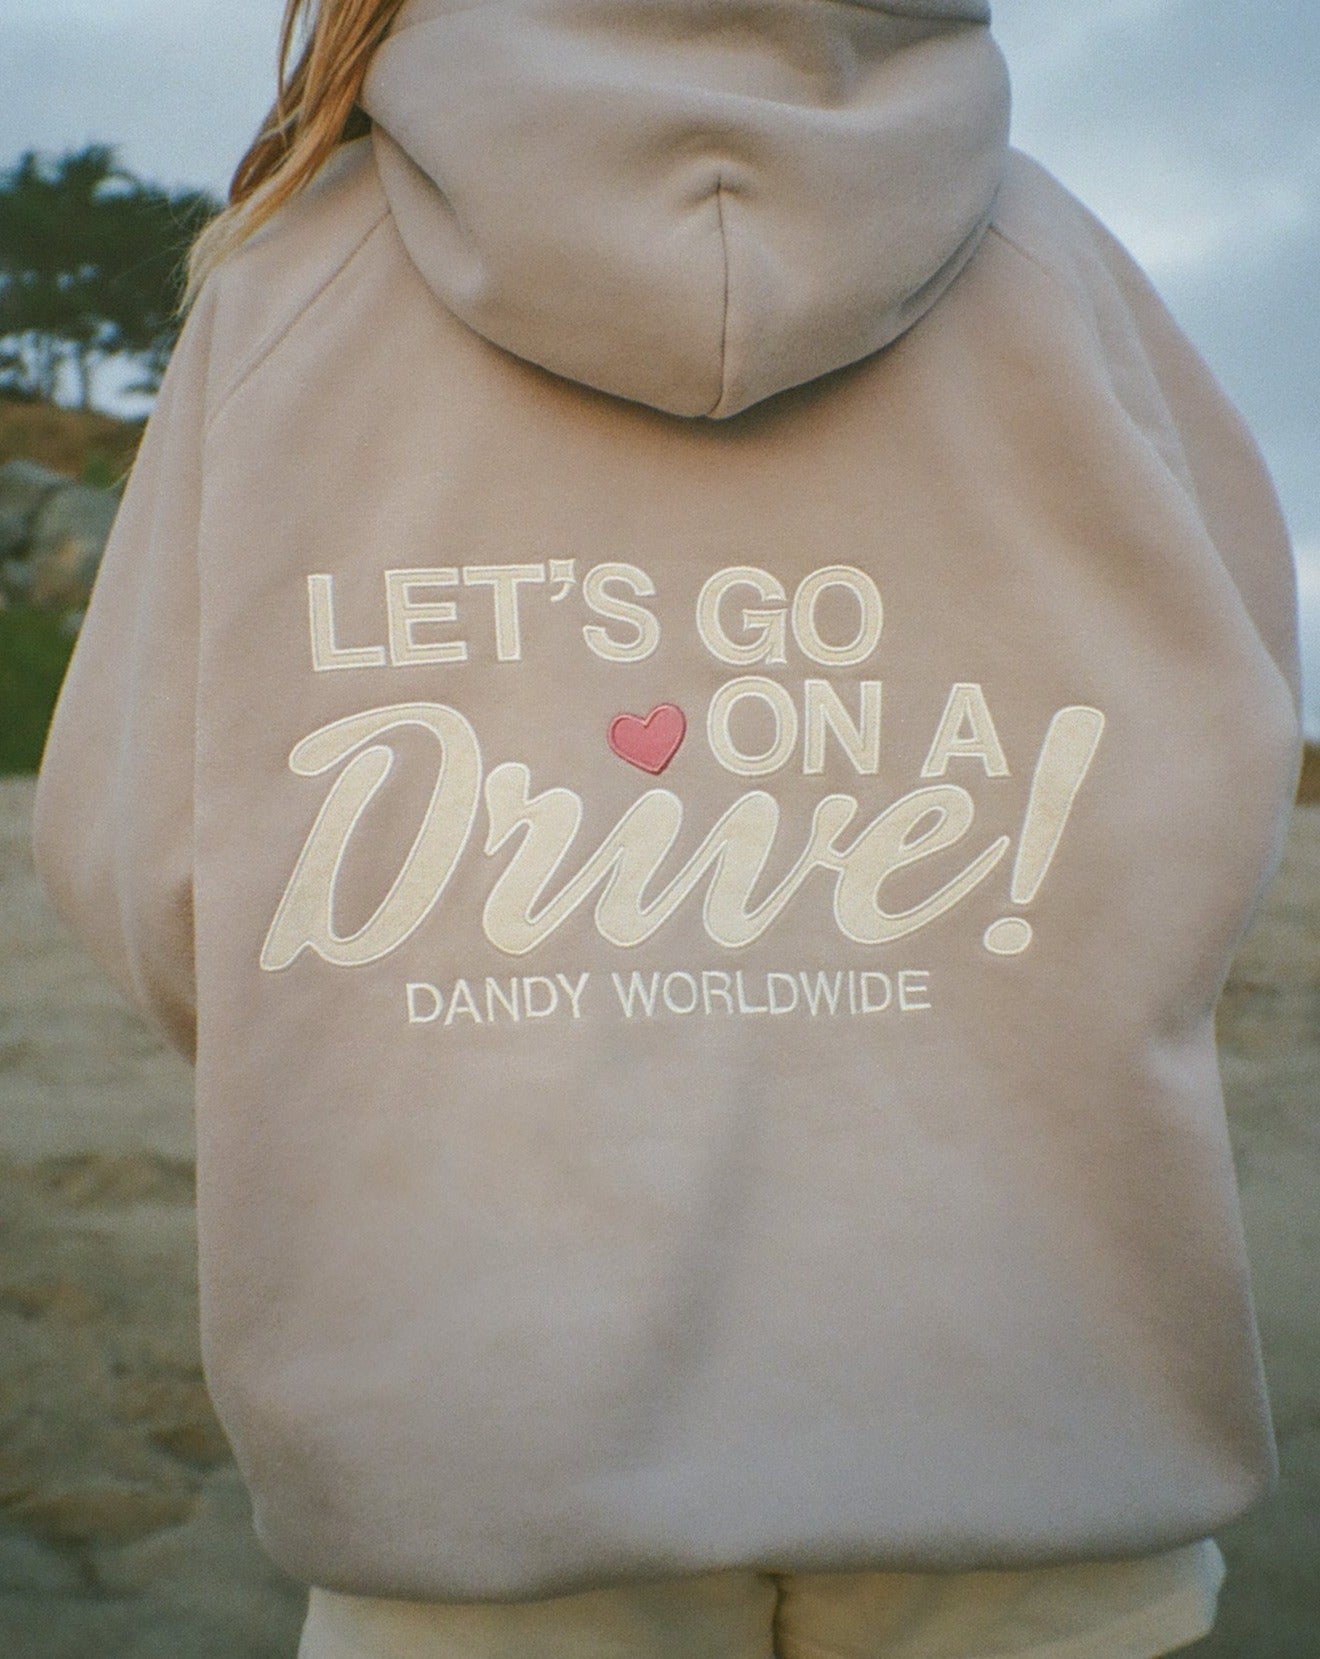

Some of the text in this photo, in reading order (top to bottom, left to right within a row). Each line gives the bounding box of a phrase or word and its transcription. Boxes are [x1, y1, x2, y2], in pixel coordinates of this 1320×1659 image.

[306, 558, 884, 672] LET'S GO
[705, 675, 1011, 779] ON A
[259, 701, 1106, 972] Drive!
[405, 969, 932, 1027] DANDY WORLDWIDE
